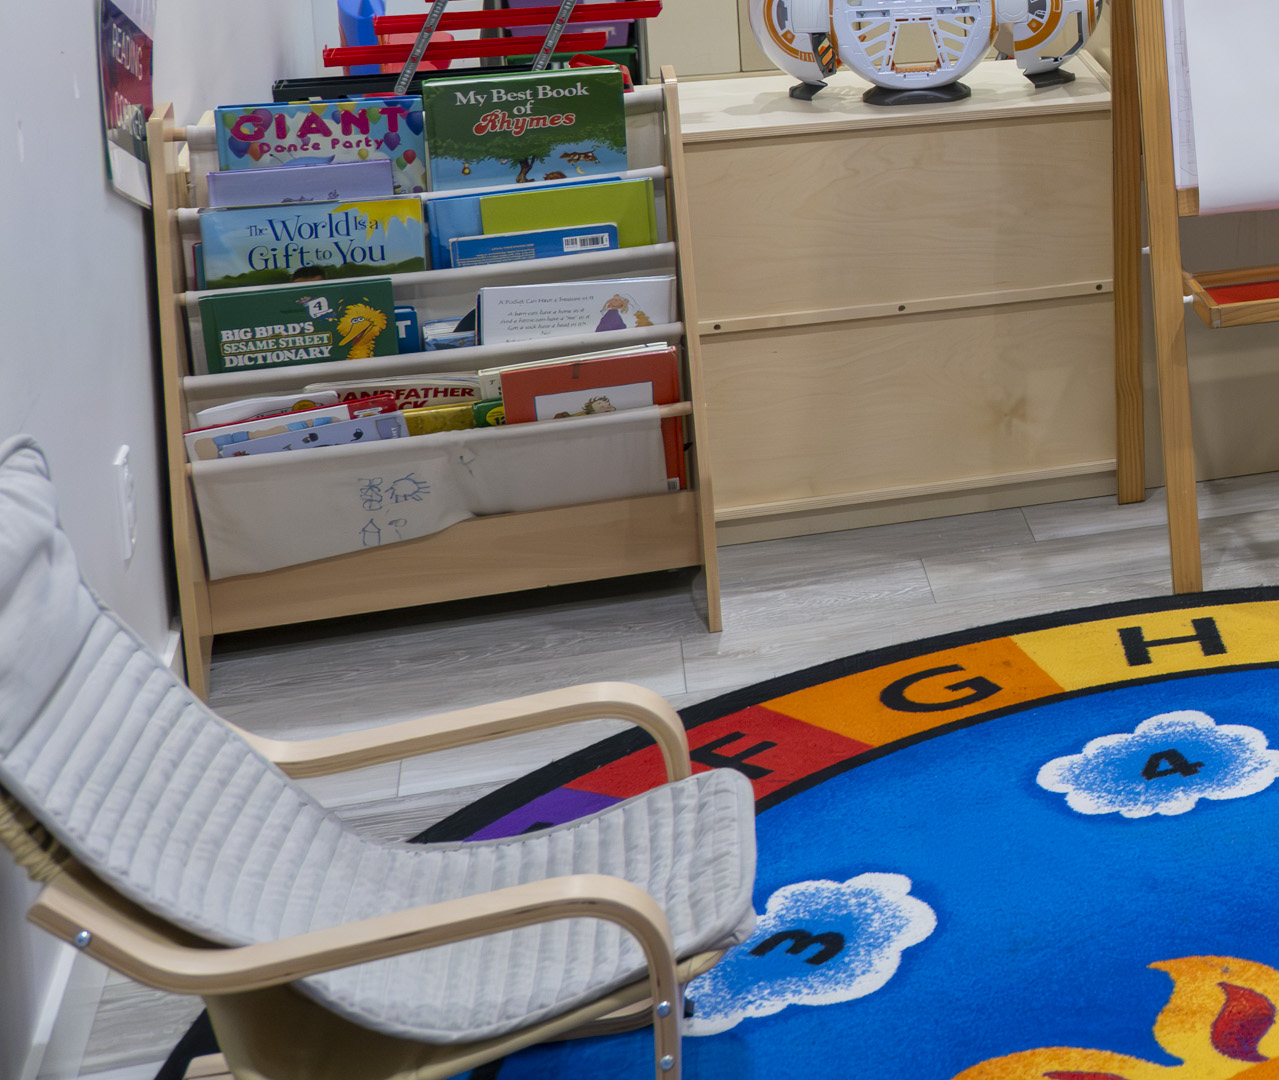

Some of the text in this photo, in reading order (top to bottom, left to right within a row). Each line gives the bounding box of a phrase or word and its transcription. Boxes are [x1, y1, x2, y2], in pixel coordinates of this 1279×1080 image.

[112, 23, 143, 81] READING
[454, 82, 589, 107] My Best Book
[513, 100, 534, 115] of
[230, 107, 405, 142] GIANT
[474, 110, 576, 136] Rhymes
[259, 137, 384, 154] Dance Party
[248, 212, 379, 241] The World Is a
[248, 239, 386, 271] Gift to You
[313, 301, 322, 311] 4
[220, 322, 314, 342] BIG BIRD'S
[223, 333, 331, 354] SESAME STREET
[223, 345, 333, 368] DICTIONARY
[1116, 618, 1227, 667] H
[879, 664, 1004, 714] G
[1140, 748, 1204, 782] 4
[749, 928, 845, 966] 3
